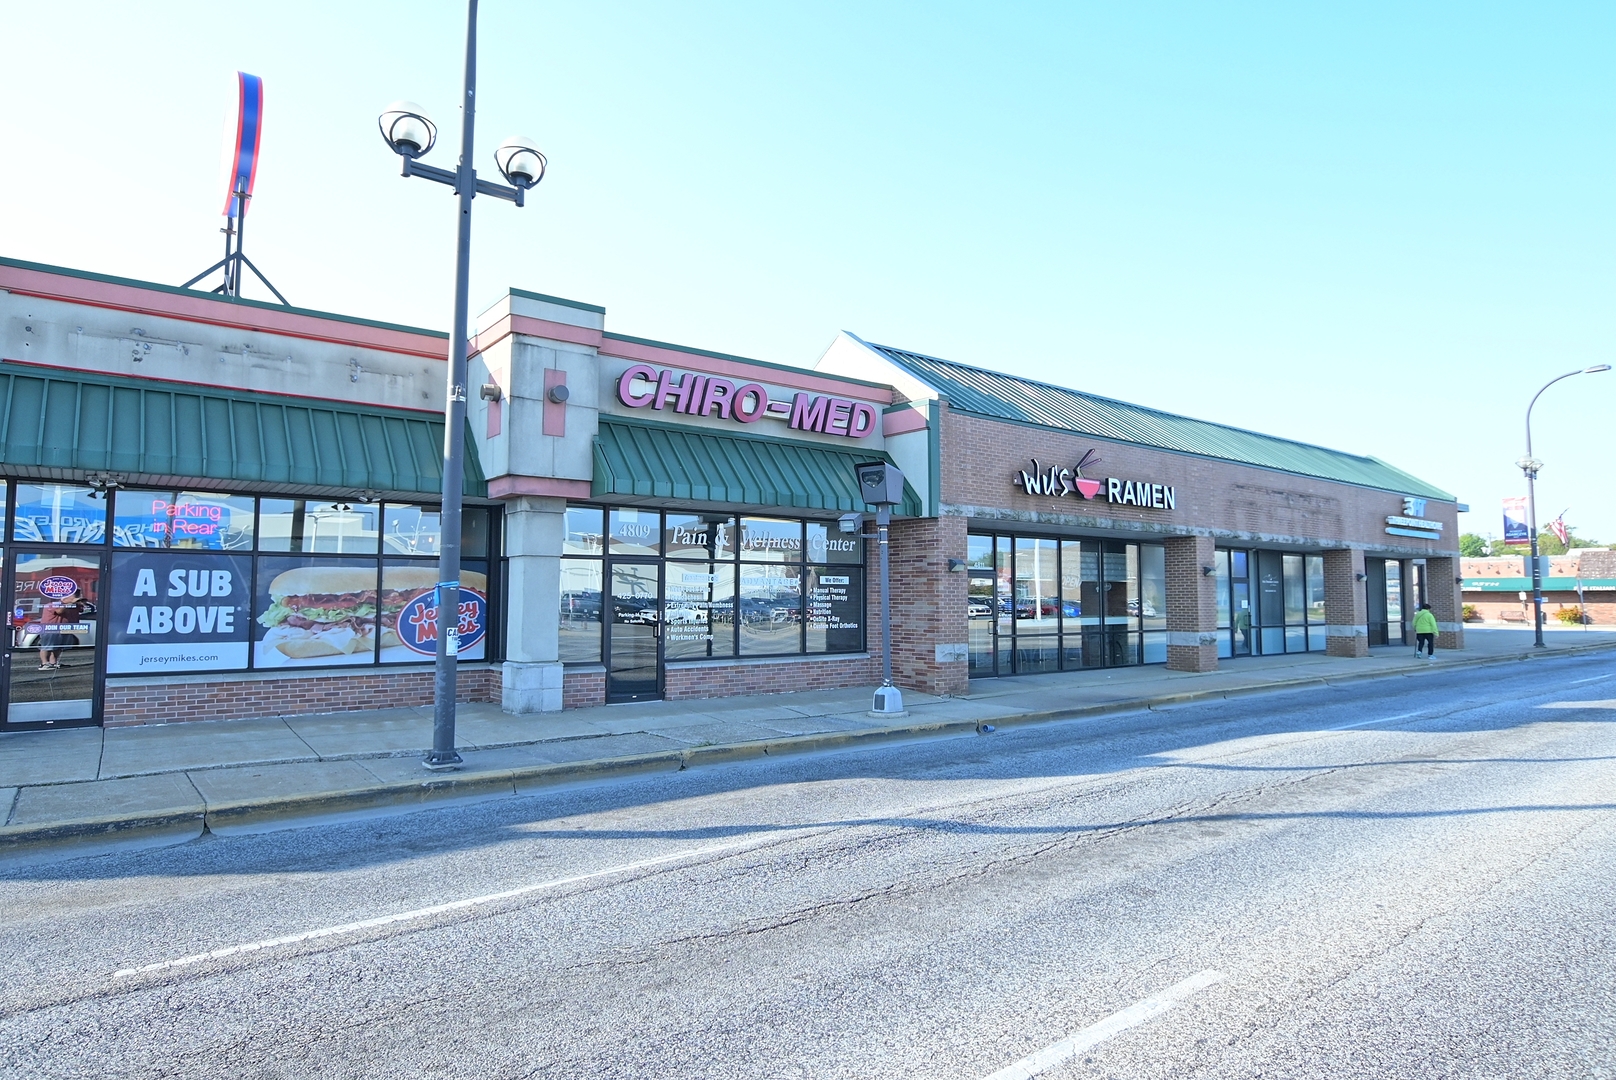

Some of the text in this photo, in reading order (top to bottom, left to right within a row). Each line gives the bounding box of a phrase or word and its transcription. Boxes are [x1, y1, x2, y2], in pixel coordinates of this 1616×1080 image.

[617, 364, 877, 439] CHIRO-MED
[1105, 477, 1175, 510] RAMEN
[152, 500, 221, 521] Parking
[153, 519, 167, 533] in
[172, 519, 218, 535] Rear
[619, 523, 650, 538] 4809
[671, 524, 856, 551] Pain & Wellness Center
[44, 579, 73, 589] Jersey
[45, 586, 73, 594] Mike's
[133, 568, 232, 597] A SUB
[617, 591, 653, 599] 425-0770
[126, 605, 235, 634] ABOVE
[408, 600, 480, 625] Jeey
[416, 616, 481, 644] Me's
[139, 654, 219, 666] jerseymikes.com
